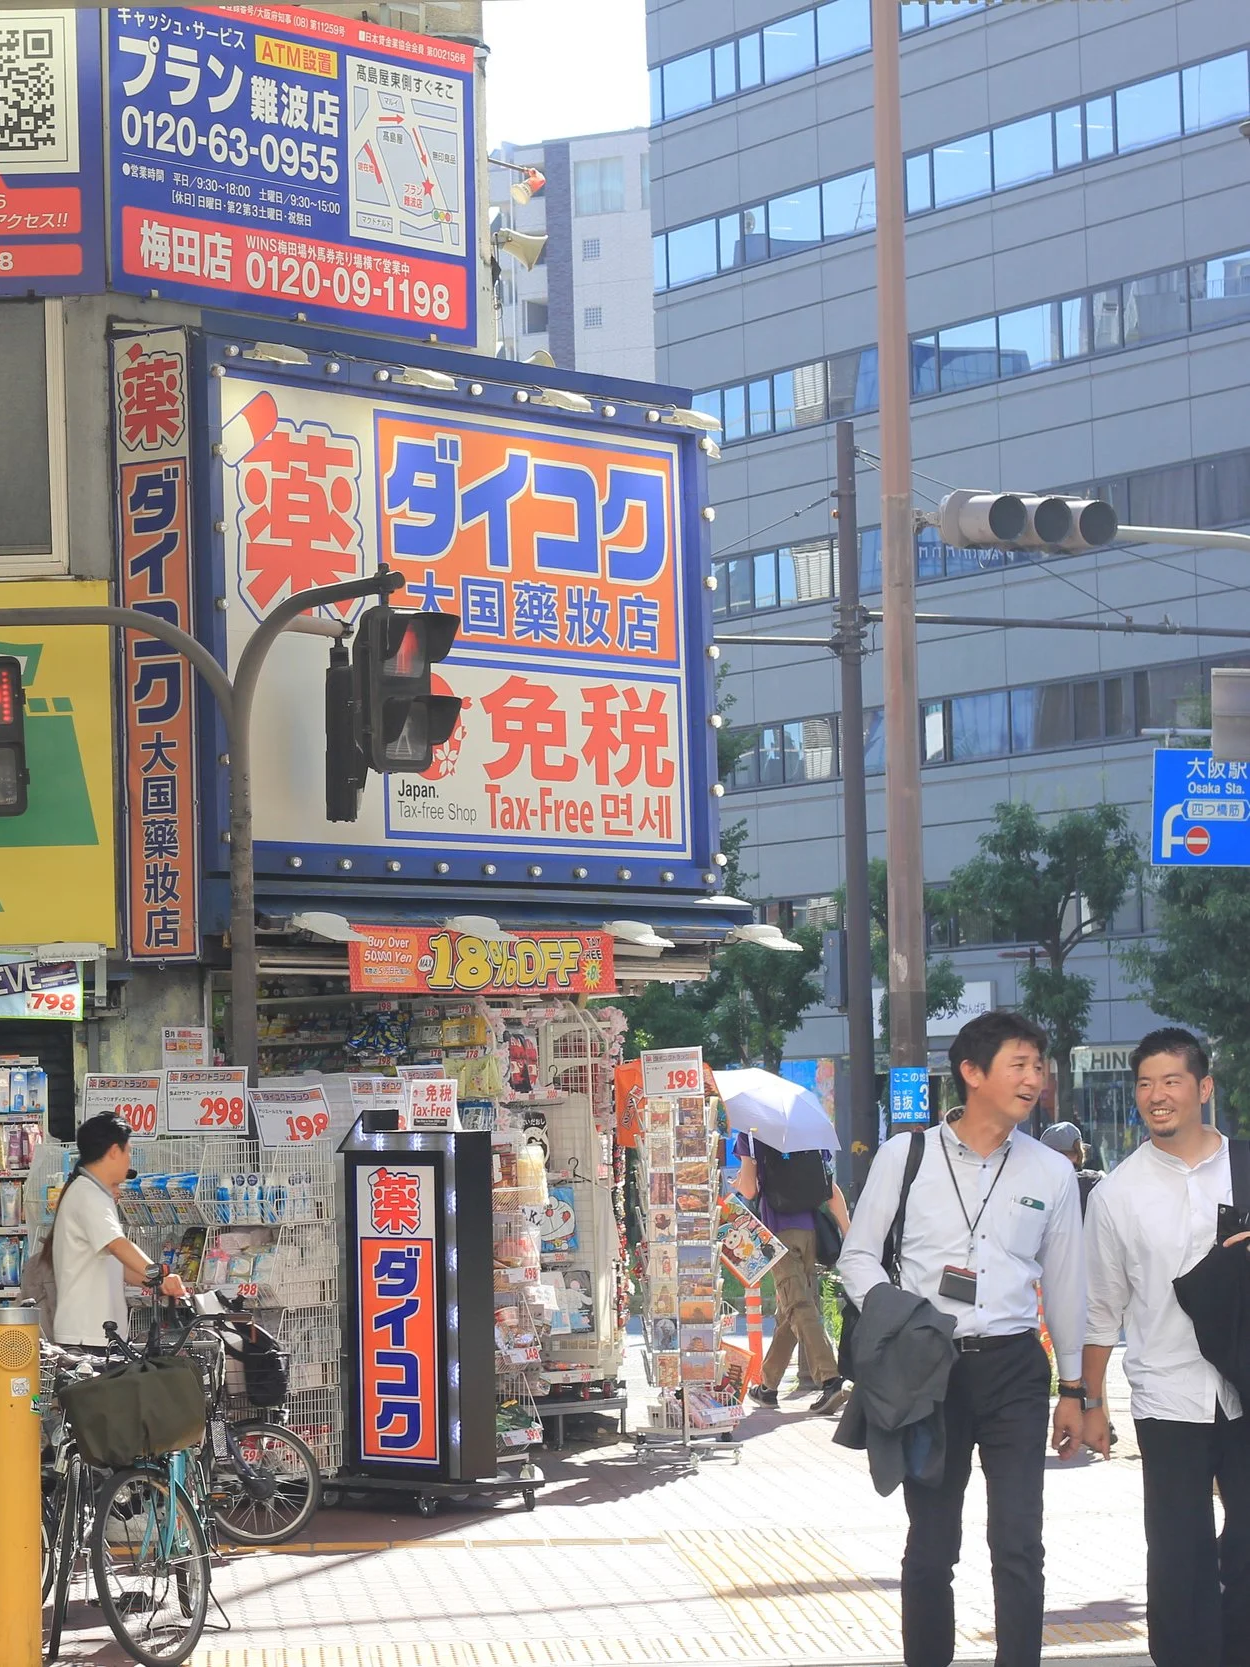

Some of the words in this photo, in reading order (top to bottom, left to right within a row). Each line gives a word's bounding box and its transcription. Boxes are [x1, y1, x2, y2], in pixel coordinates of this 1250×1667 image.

[118, 7, 245, 50] キャッシュ・サービス
[293, 16, 309, 29] (08)
[310, 19, 345, 37] 第11259号
[261, 41, 332, 75] ATM設置
[365, 32, 425, 56] 日本貸金業協会会員
[426, 45, 466, 65] 第002156号
[119, 36, 244, 113] プラン
[251, 75, 339, 138] 難波店
[121, 105, 338, 184] 0120-63-0955
[432, 151, 456, 165] 無印良品
[131, 165, 165, 183] 営業時間
[140, 220, 233, 282] 梅田店
[246, 234, 410, 275] WINS梅田場外馬券売り場横で営業中
[246, 257, 451, 321] 0120-09-1198
[123, 357, 180, 444] 薬
[244, 430, 356, 620] 薬
[387, 438, 665, 582] ダイコク
[130, 467, 182, 724] ダイコク
[480, 675, 675, 788] 免税
[1186, 757, 1248, 779] 大阪駅
[398, 779, 439, 801] Japan.
[1188, 781, 1221, 794] Osaka
[1225, 782, 1245, 795] Sta.
[398, 800, 445, 820] Tax-free
[448, 803, 477, 823] Shop
[485, 783, 594, 833] Tax-Free
[601, 793, 673, 839] 면세
[1192, 803, 1239, 816] 四つ橋筋
[364, 951, 392, 963] 50,000
[394, 951, 412, 963] Yen
[367, 936, 385, 948] Buy
[388, 937, 409, 948] Over
[419, 959, 432, 969] MAX
[428, 933, 582, 989] 18%OFF
[1070, 1052, 1133, 1070] IHIN
[412, 1103, 451, 1117] Tax-Free
[425, 1084, 452, 1102] 免税
[919, 1084, 930, 1111] 3
[374, 1174, 418, 1232] 薬
[237, 1283, 258, 1296] 298
[373, 1247, 422, 1451] ダイコク
